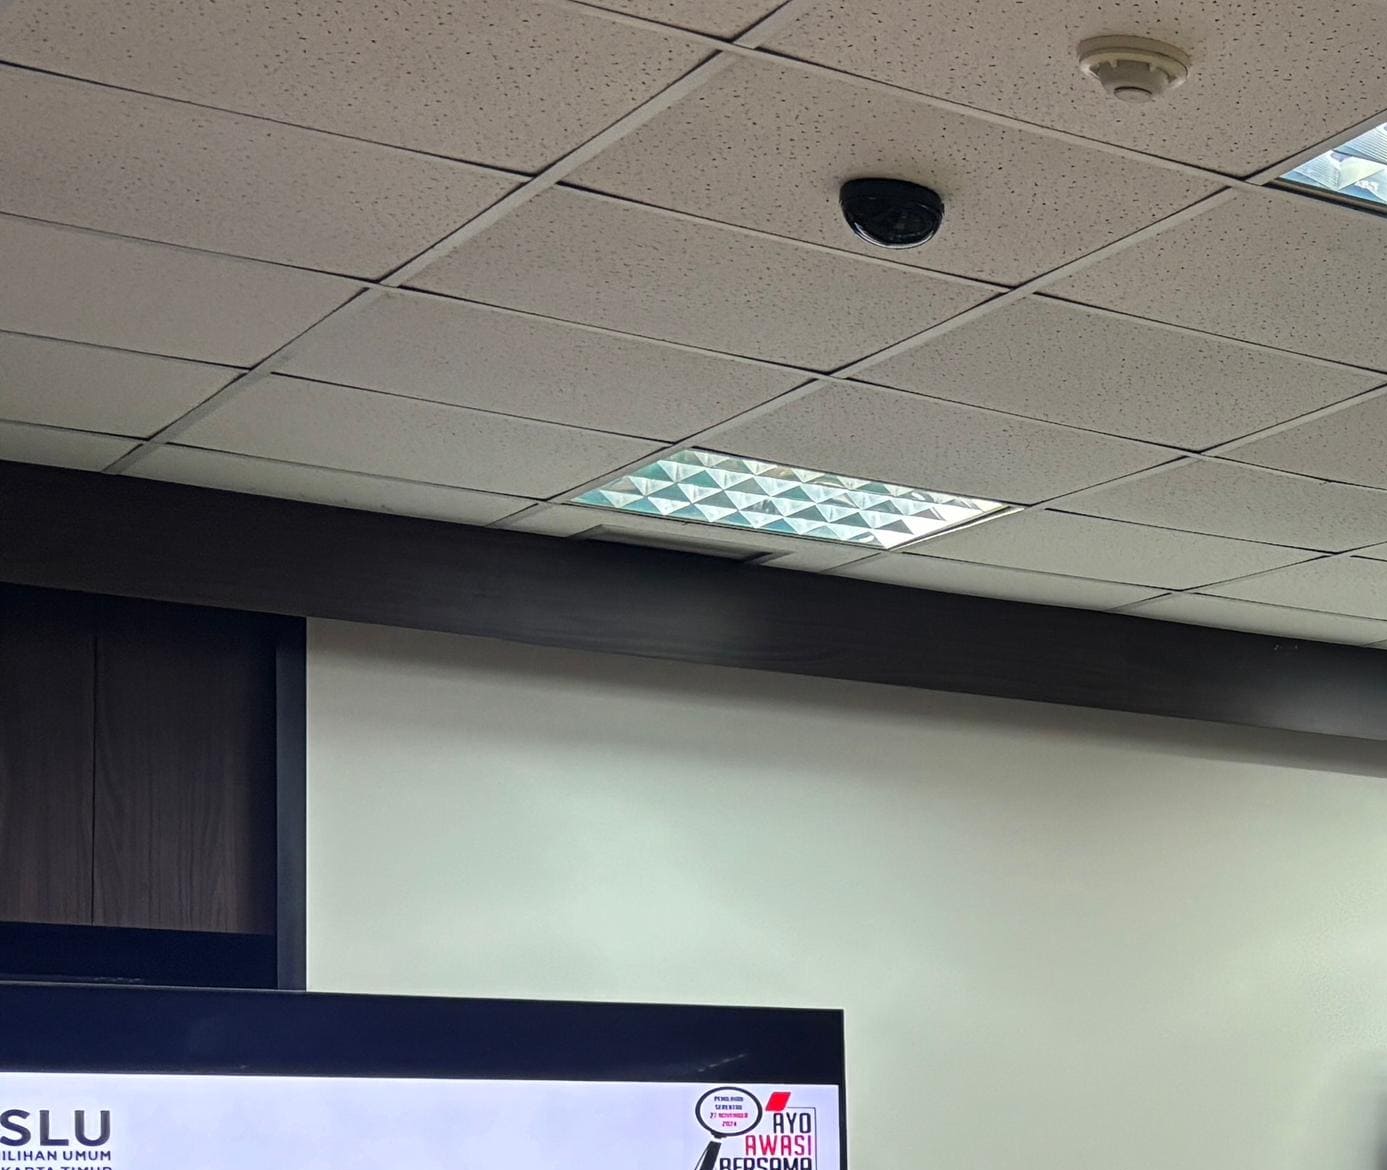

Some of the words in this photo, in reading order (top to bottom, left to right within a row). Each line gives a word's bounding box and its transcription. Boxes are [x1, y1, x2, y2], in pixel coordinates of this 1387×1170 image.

[0, 1108, 111, 1147] SLU
[773, 1112, 811, 1134] AYO
[62, 1150, 111, 1161] UMUM
[745, 1134, 811, 1156] AWASI
